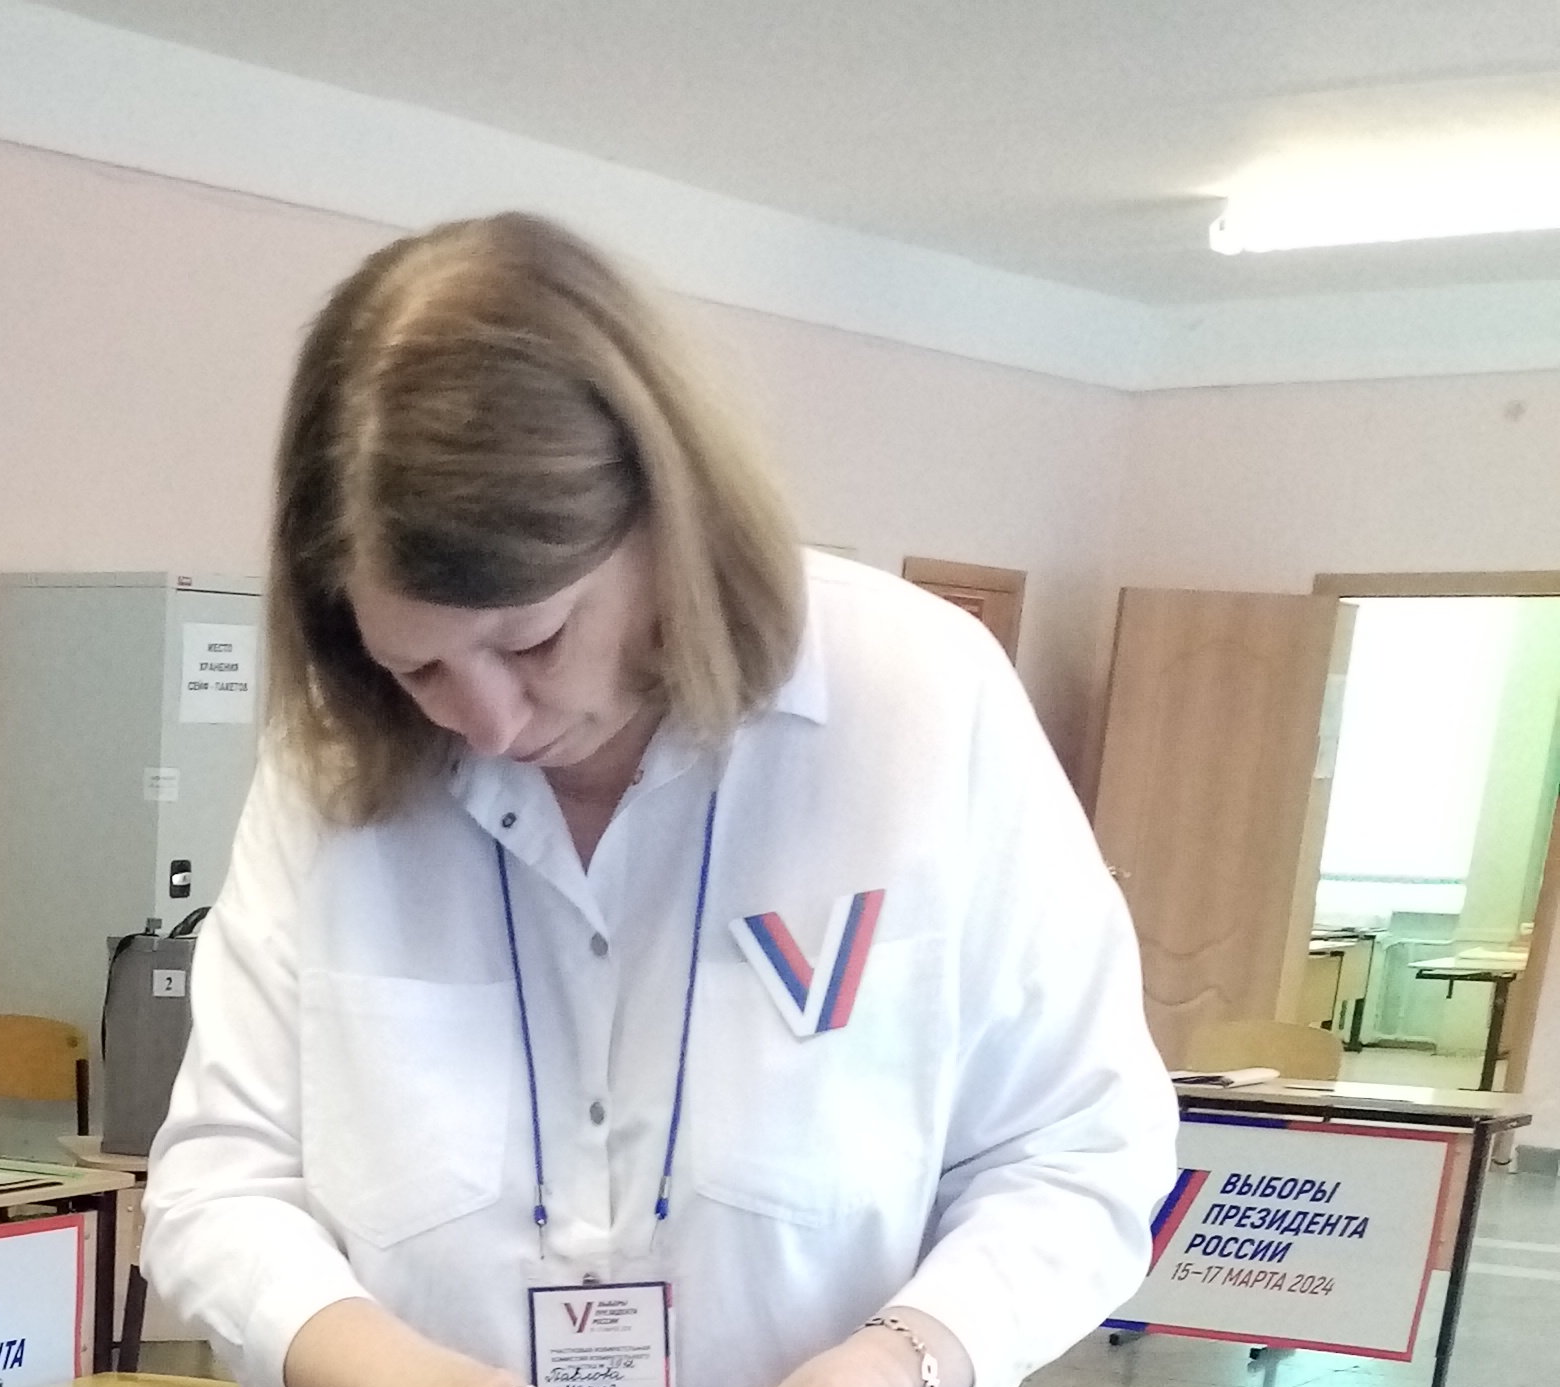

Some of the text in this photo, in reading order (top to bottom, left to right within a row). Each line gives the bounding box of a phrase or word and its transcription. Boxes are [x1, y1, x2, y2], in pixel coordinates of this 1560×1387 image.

[165, 976, 173, 991] 2
[1220, 1173, 1341, 1203] ВЫБОРЫ
[1202, 1203, 1370, 1239] ПРЕЗИДЕНТА
[1184, 1233, 1293, 1263] РОССИИ
[1221, 1267, 1287, 1291] МАРТА
[1287, 1273, 1335, 1296] 2024
